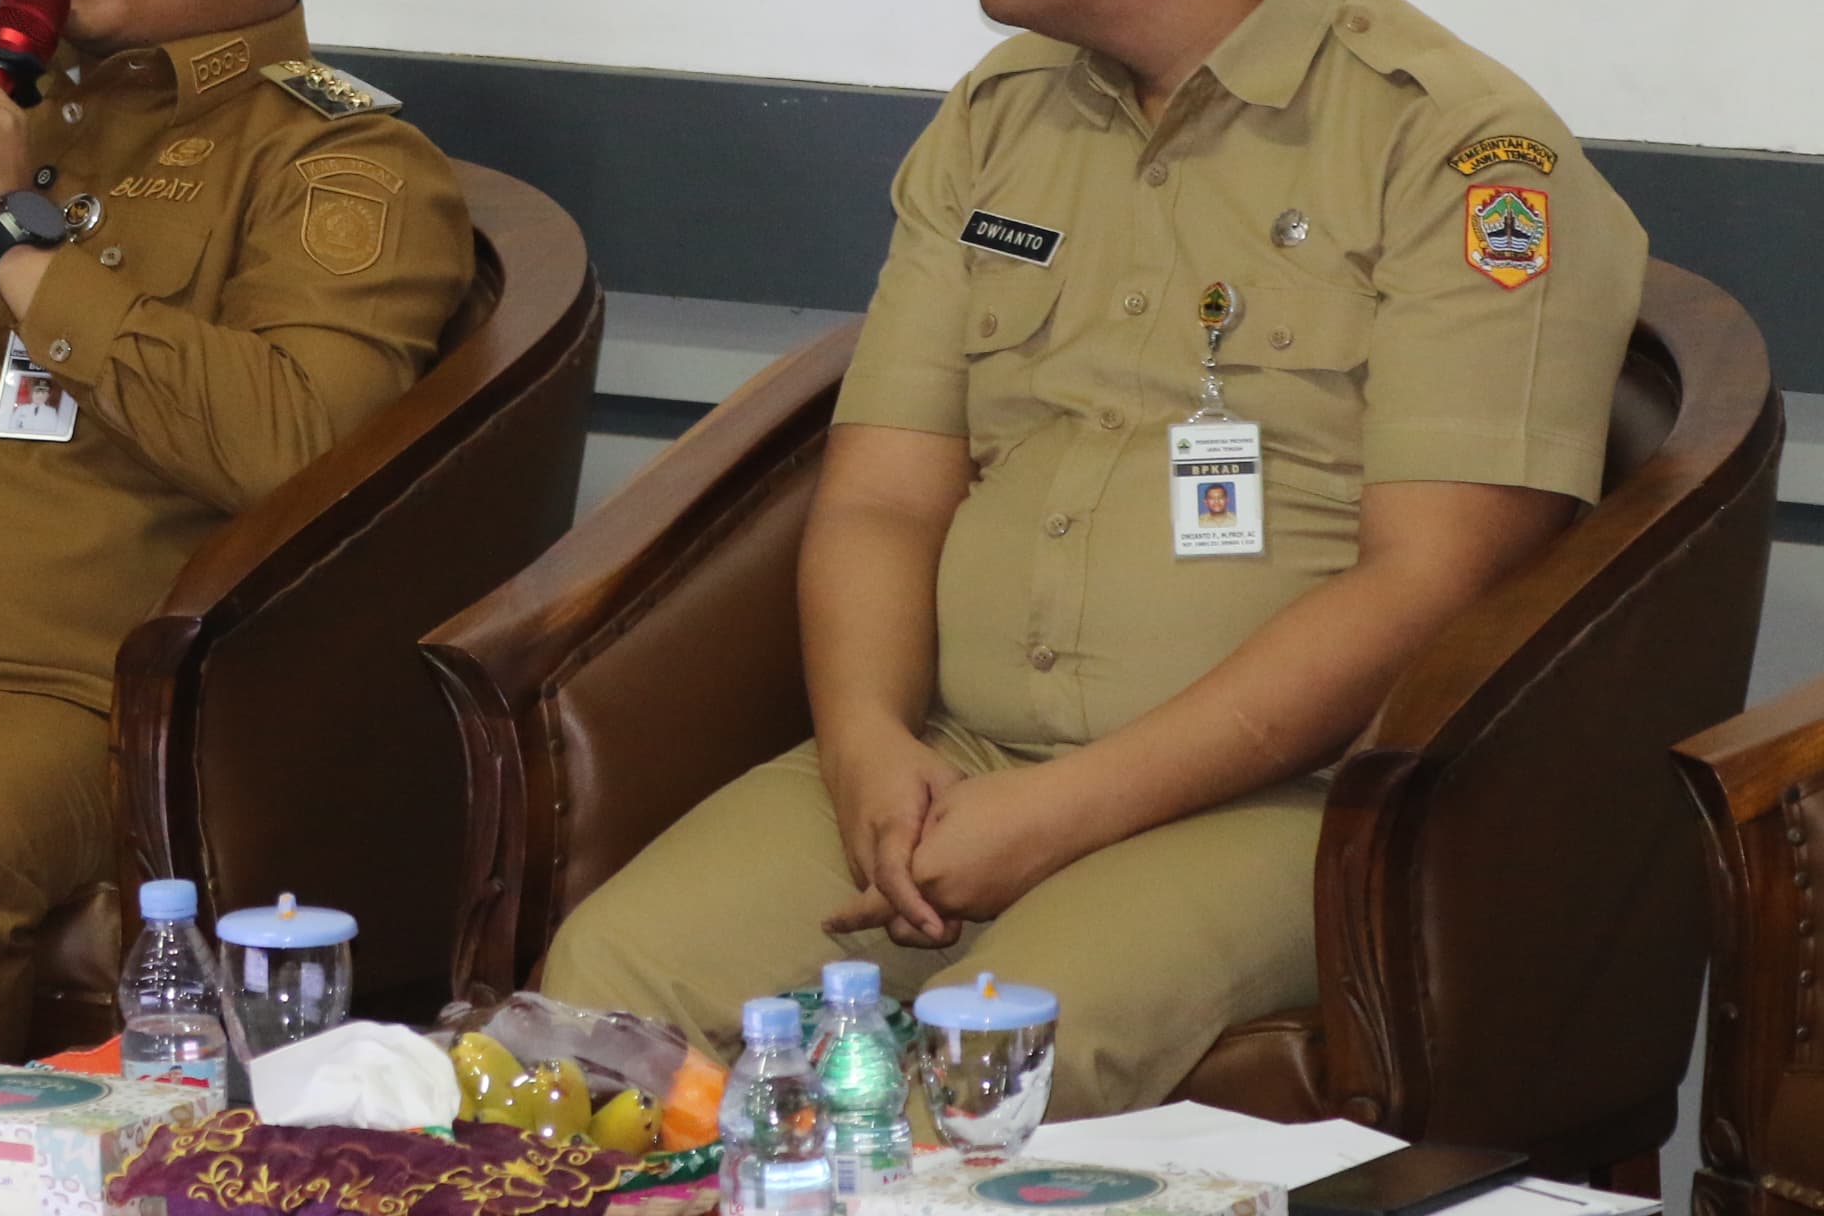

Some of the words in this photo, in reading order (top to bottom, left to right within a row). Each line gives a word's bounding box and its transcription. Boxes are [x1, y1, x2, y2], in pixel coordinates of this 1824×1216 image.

[1452, 138, 1524, 167] PEMERINTAH
[1471, 151, 1500, 170] JAWA
[109, 176, 204, 202] BUPATI
[976, 221, 1044, 251] DWIANTO
[1191, 464, 1240, 475] BPKAD
